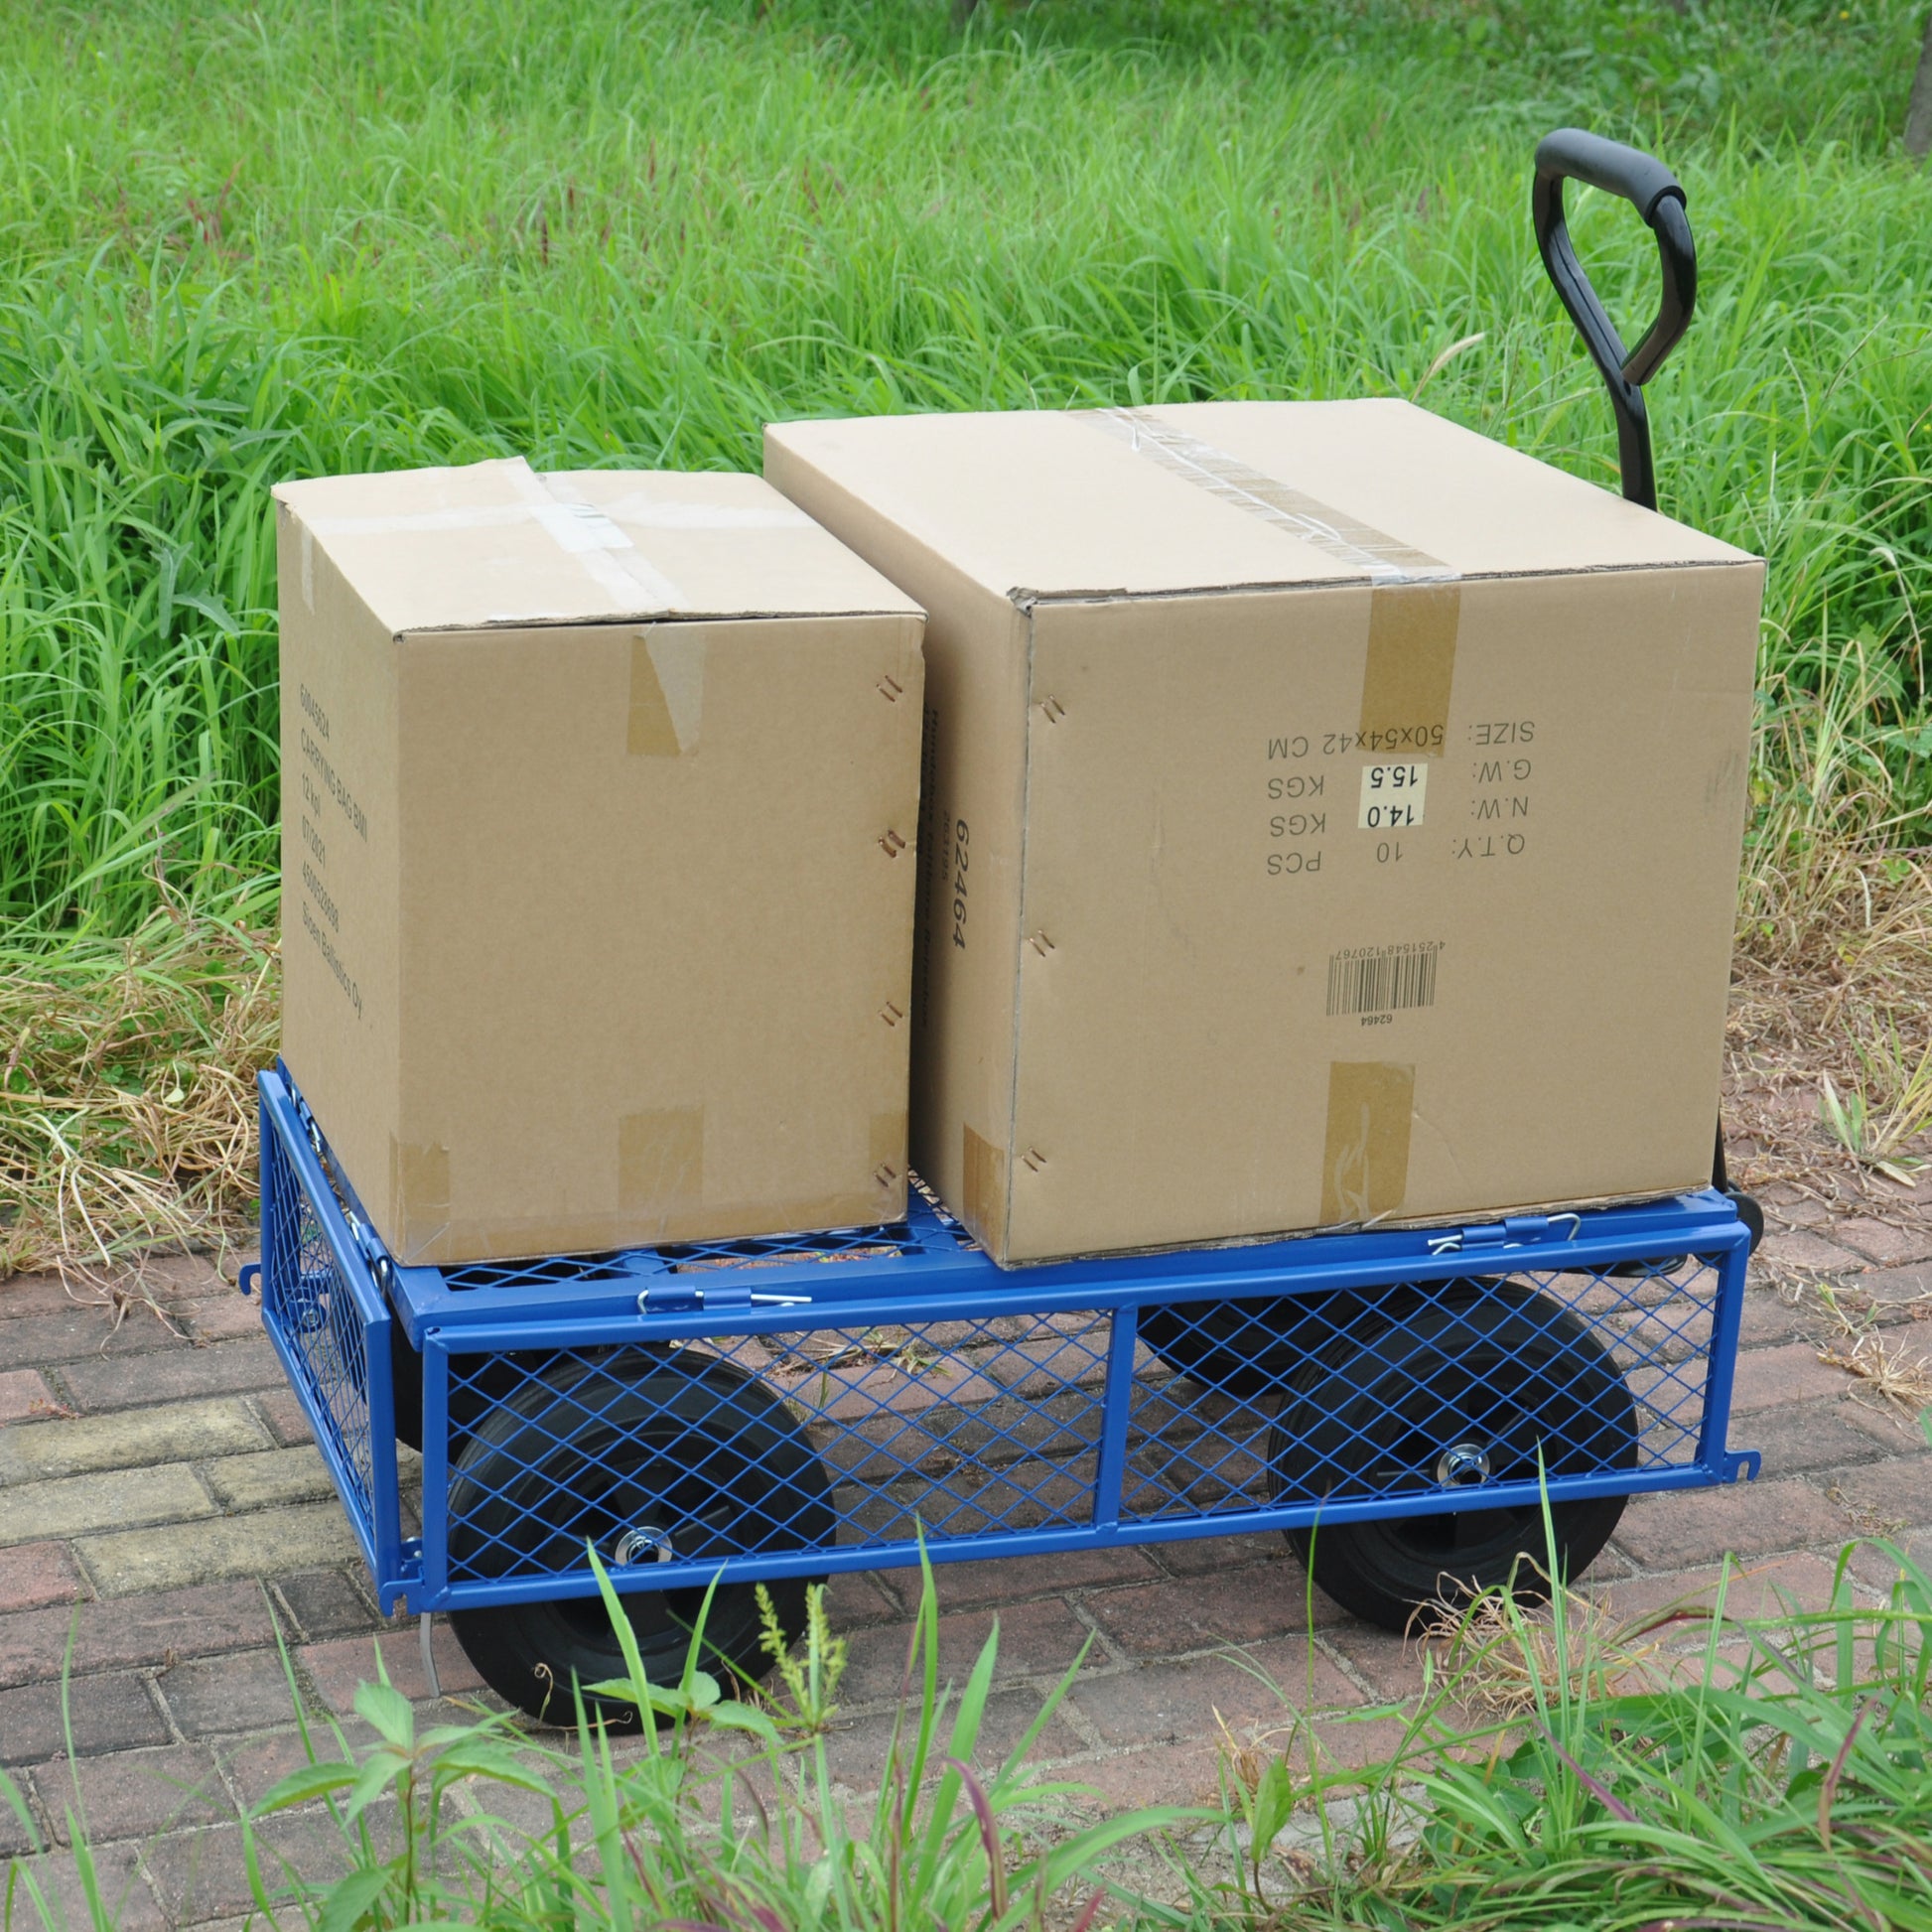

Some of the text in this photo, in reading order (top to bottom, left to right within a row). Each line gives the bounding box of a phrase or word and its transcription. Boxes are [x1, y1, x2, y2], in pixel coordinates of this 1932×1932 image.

[1268, 721, 1535, 759] SIZE: 50x54x42 CM
[301, 727, 336, 797] CARRYING
[337, 779, 352, 820] BAG
[302, 772, 310, 802] 12
[1268, 759, 1531, 799] G.W: 15.5 KGS
[1270, 796, 1529, 837] N.W: 14.0 KGS
[1266, 833, 1525, 876] Q.T.Y: 10 PCS
[953, 818, 969, 950] 62464
[352, 982, 362, 1020] Oy
[1360, 1014, 1393, 1026] 62464
